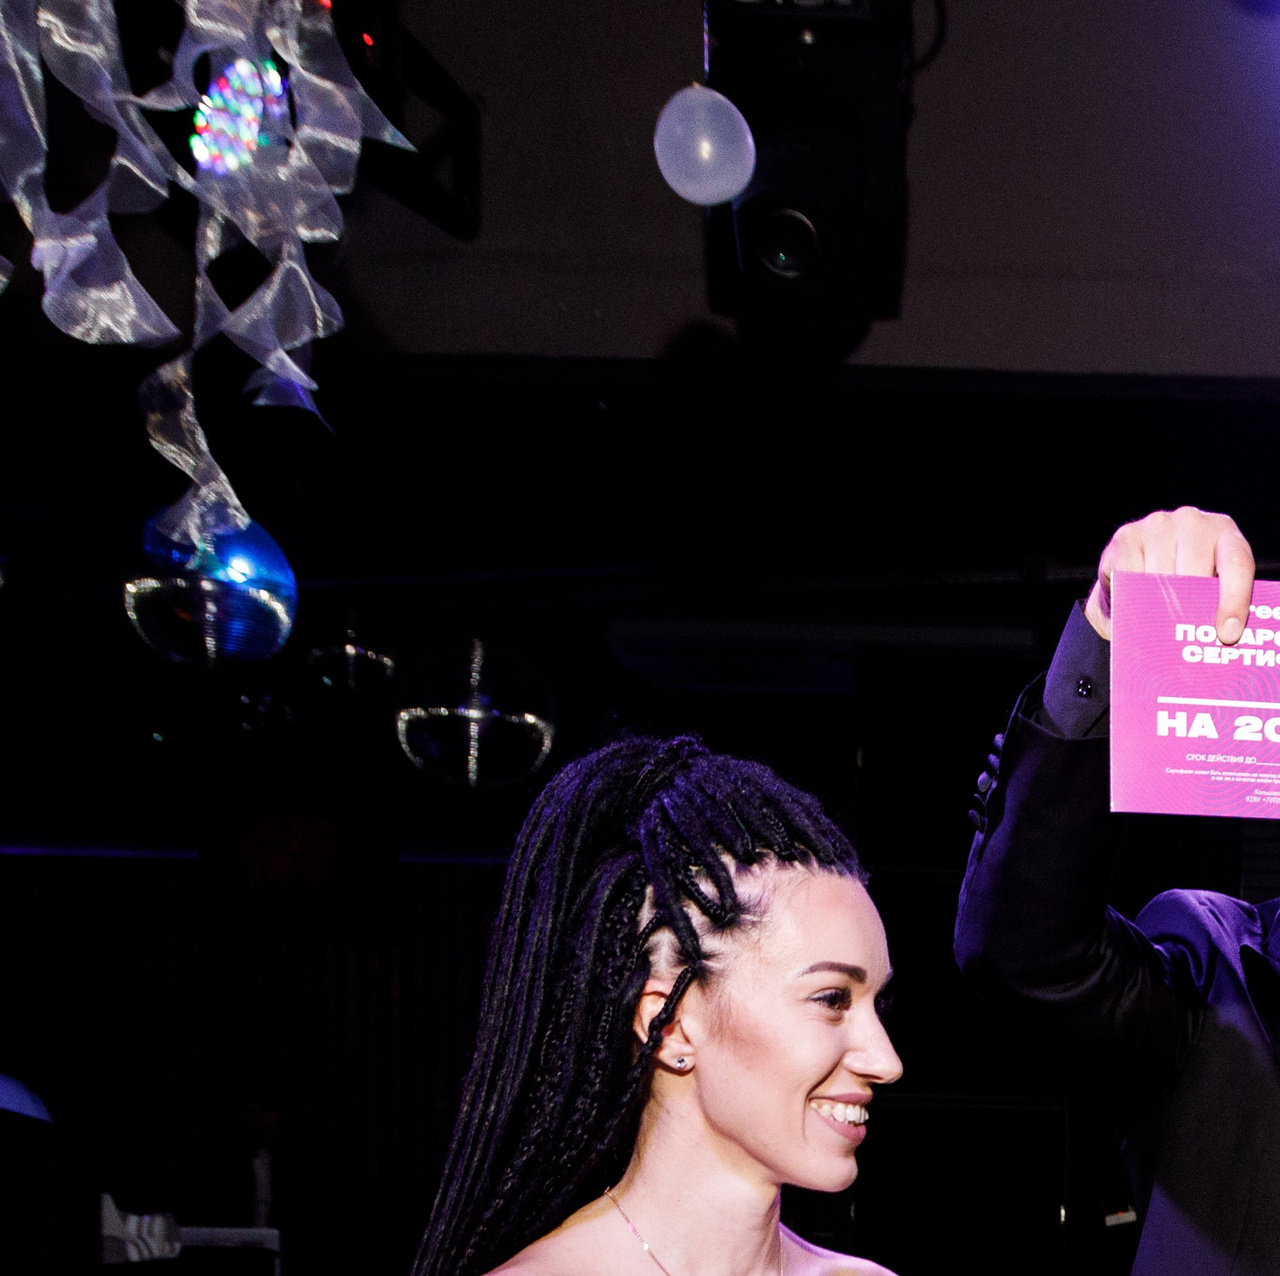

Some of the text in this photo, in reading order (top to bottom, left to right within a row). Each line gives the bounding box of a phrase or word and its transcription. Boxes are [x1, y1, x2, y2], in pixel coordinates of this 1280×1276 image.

[1157, 710, 1219, 739] НА
[1186, 753, 1257, 765] СРОК ДЕЙСТВИЯ ДО
